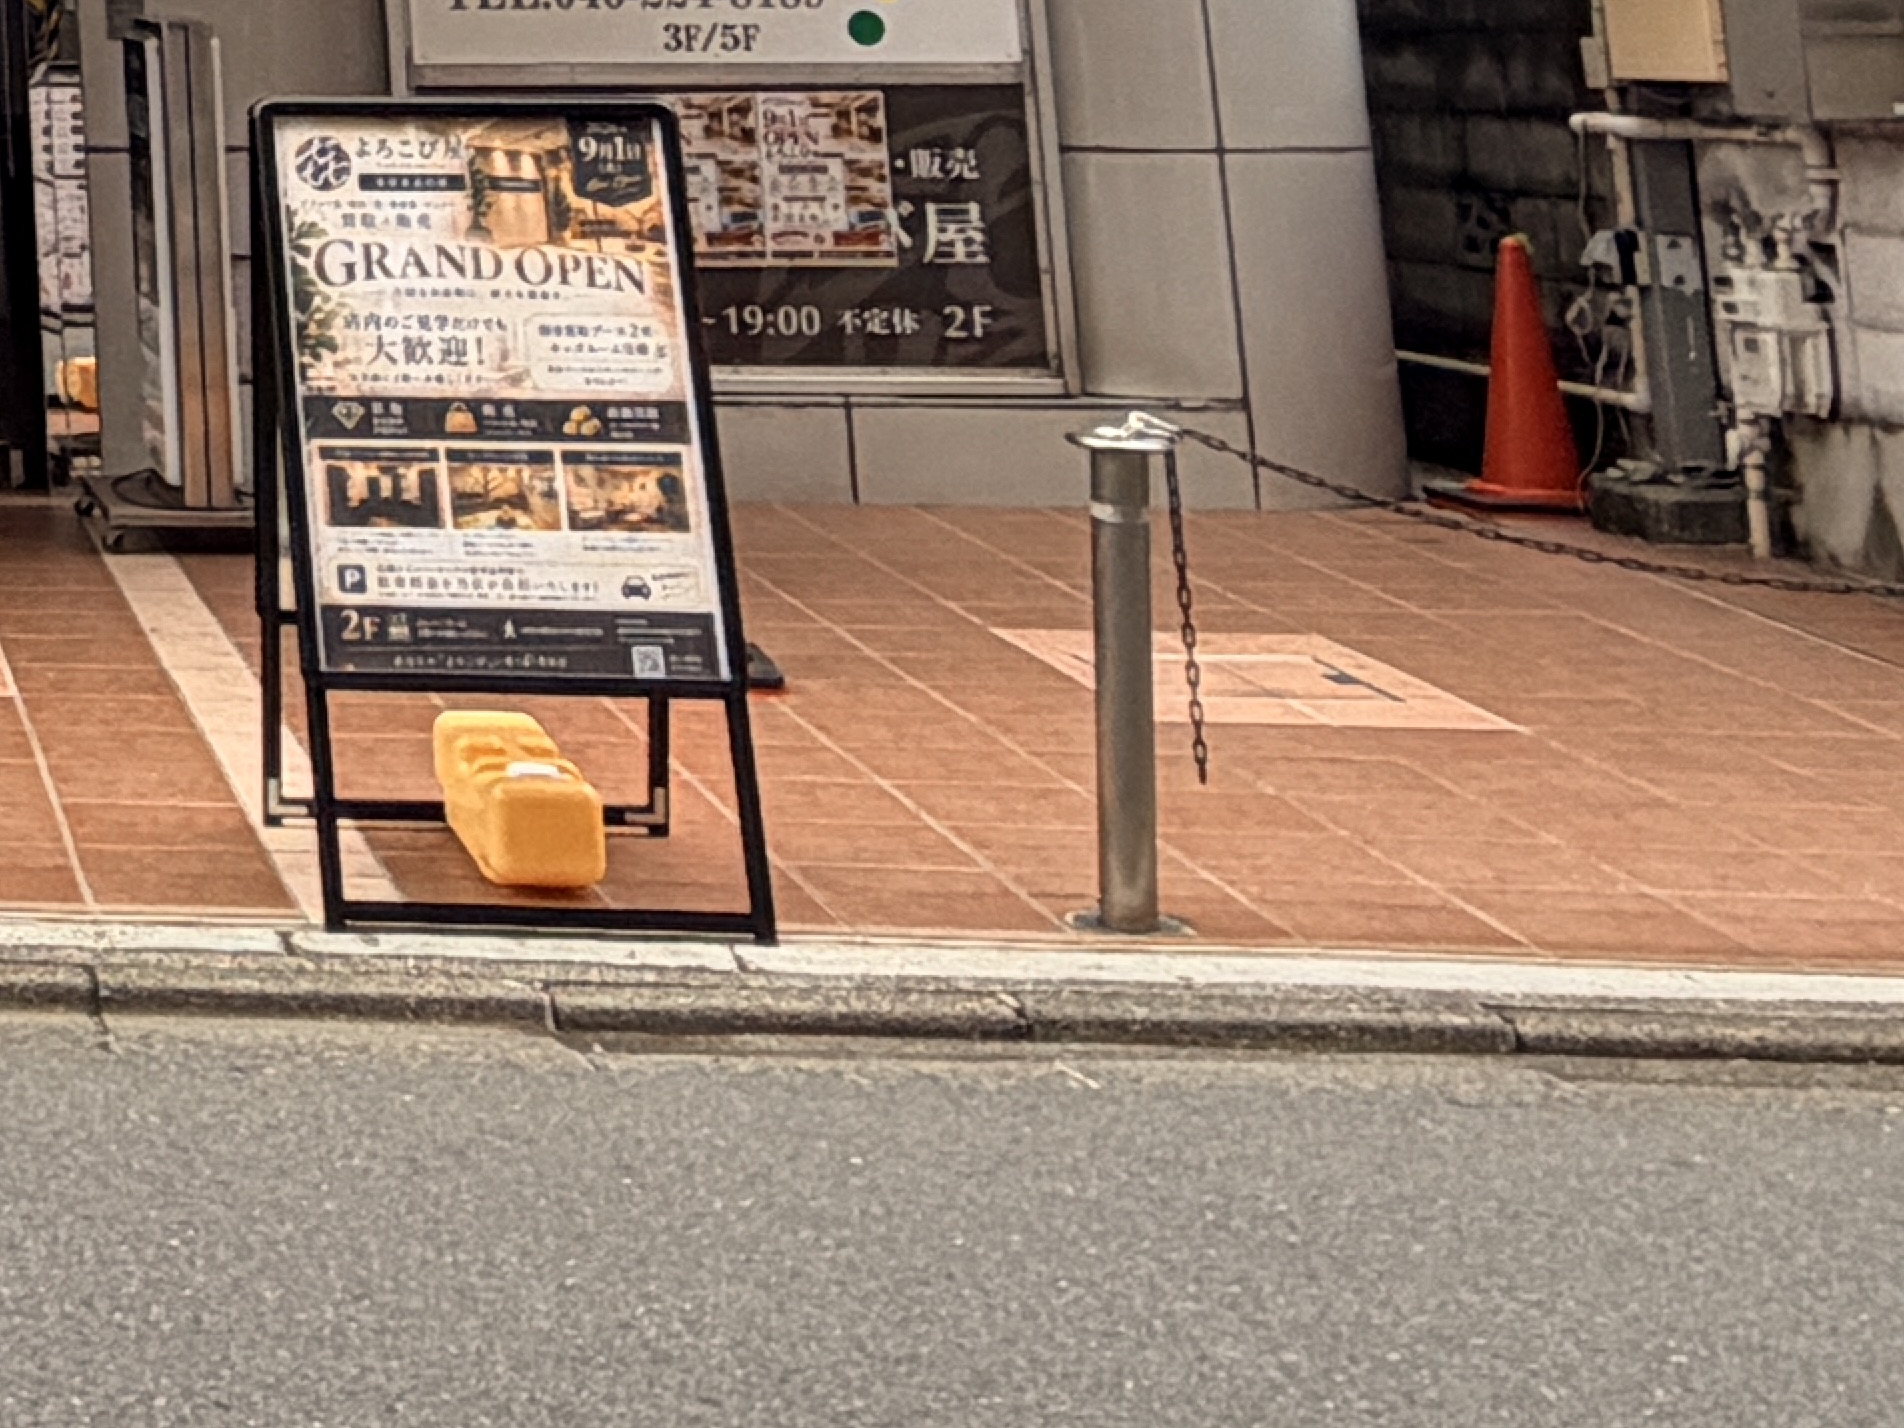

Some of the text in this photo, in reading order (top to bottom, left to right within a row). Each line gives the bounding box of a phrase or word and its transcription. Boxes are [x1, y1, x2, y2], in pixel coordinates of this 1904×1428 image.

[662, 21, 761, 53] 3F/5F
[314, 238, 647, 297] GRAND OPEN
[943, 305, 992, 338] 2F
[339, 609, 382, 642] 2F
